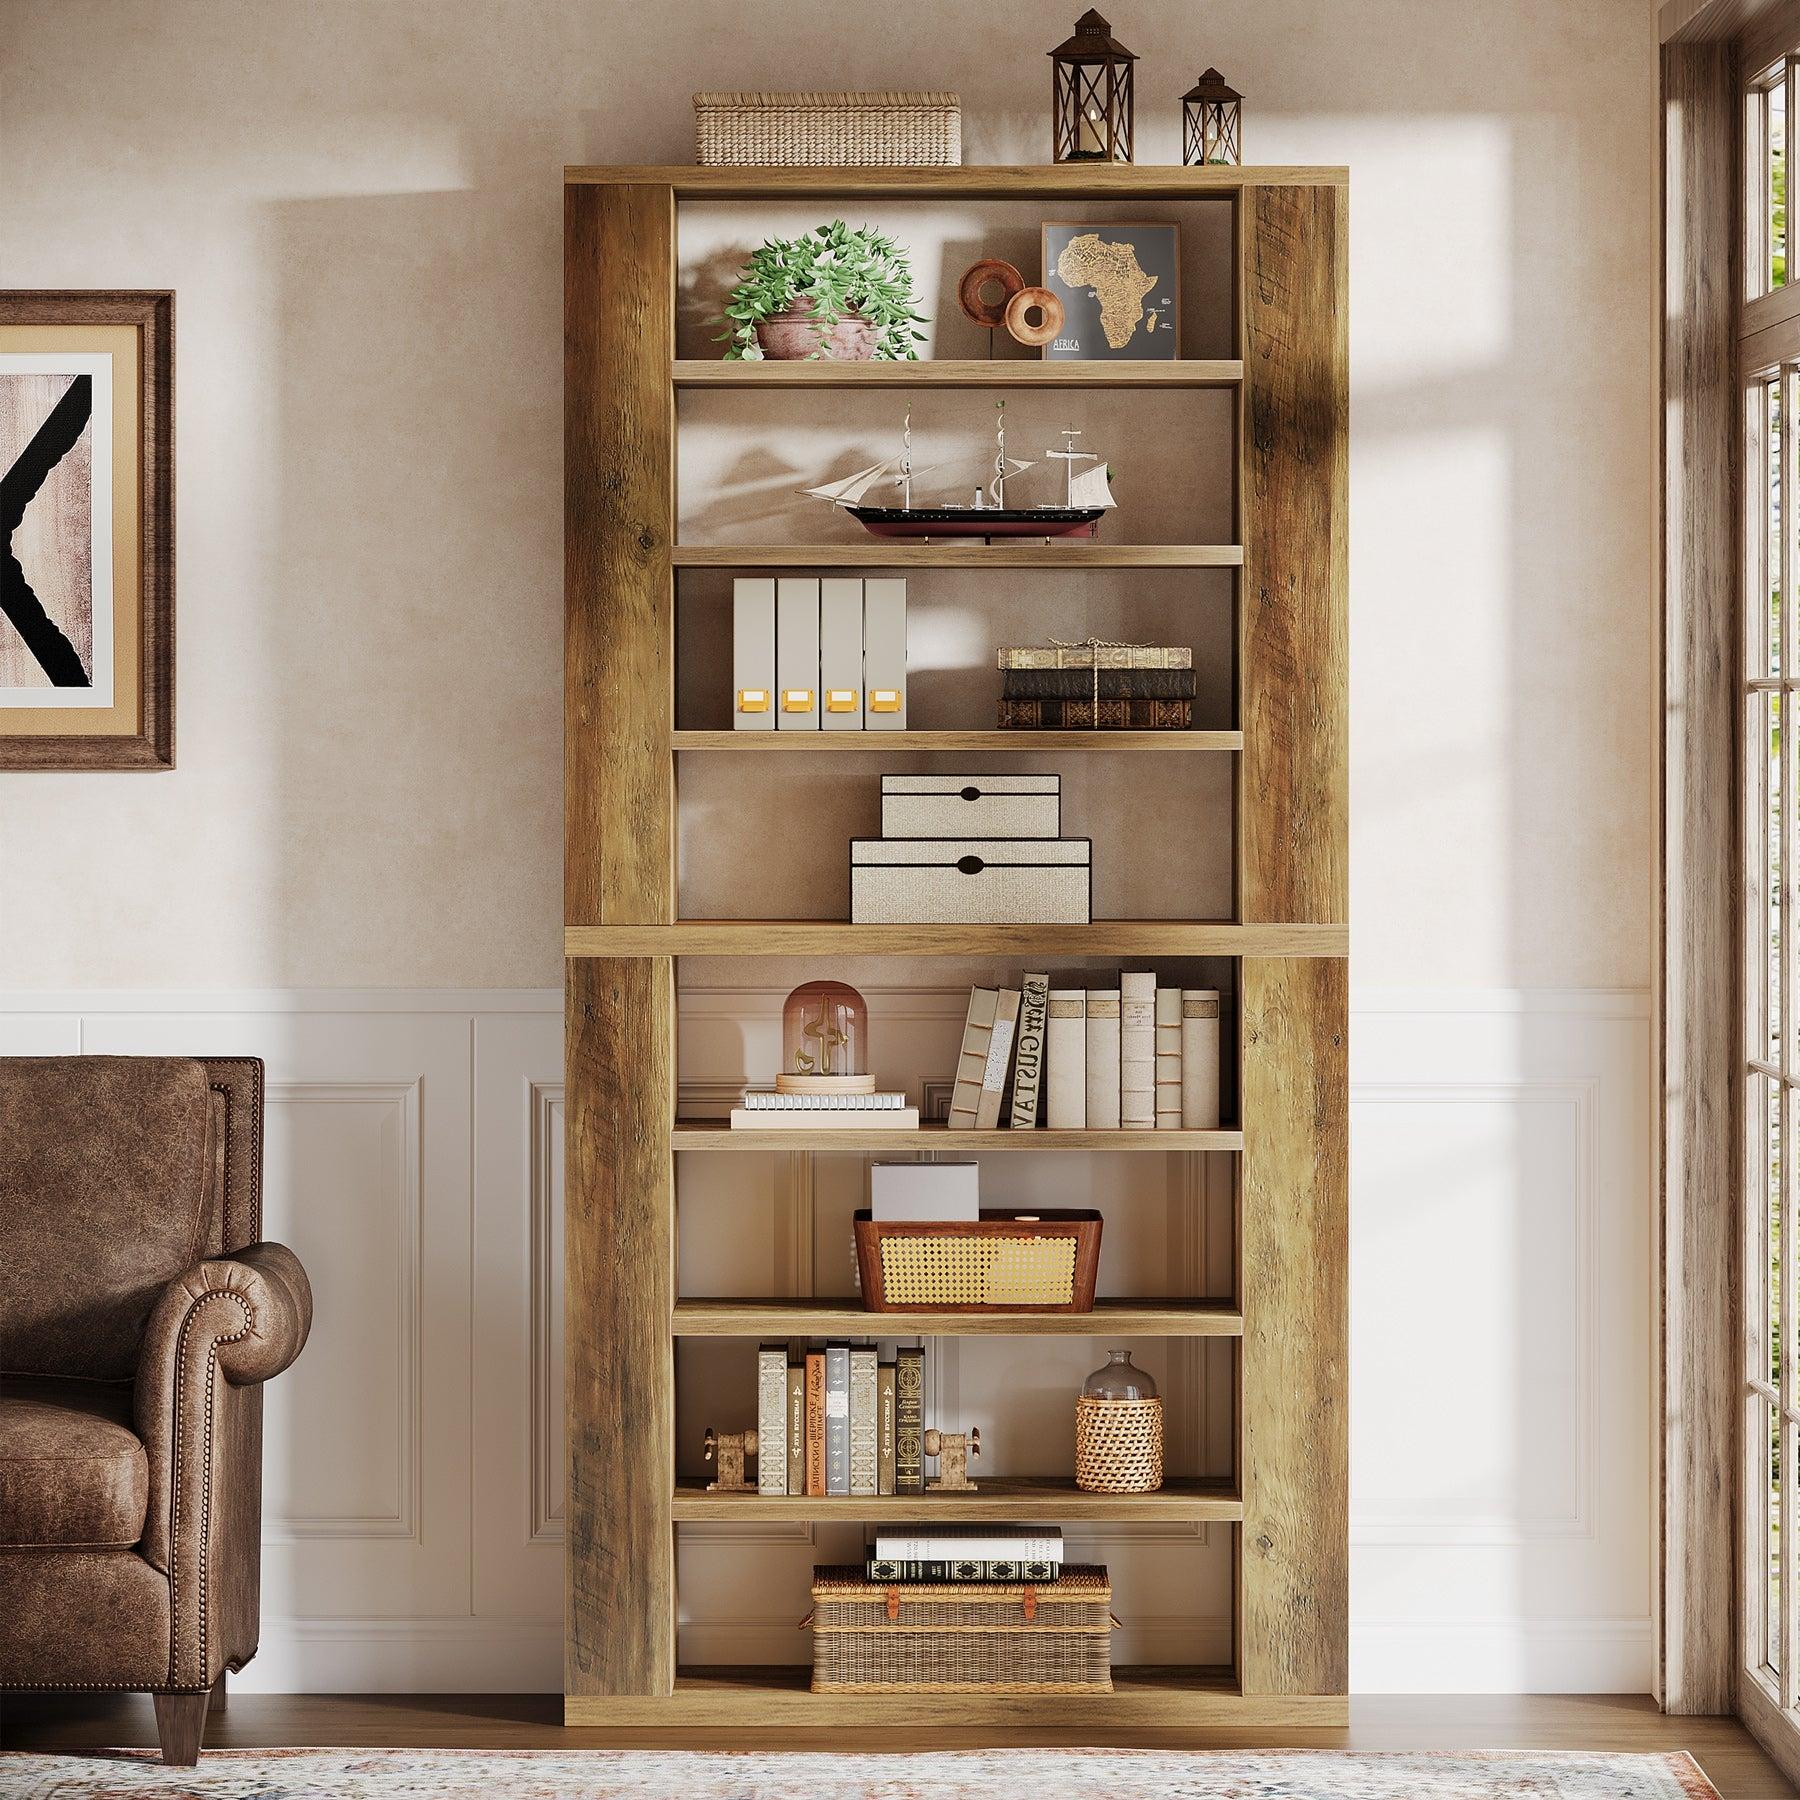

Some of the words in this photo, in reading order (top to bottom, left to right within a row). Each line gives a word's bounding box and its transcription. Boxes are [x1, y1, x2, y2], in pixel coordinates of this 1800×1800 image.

[1053, 339, 1080, 351] AFRICA
[809, 1401, 817, 1441] ШЕРЛОКЕ
[813, 1441, 820, 1449] О
